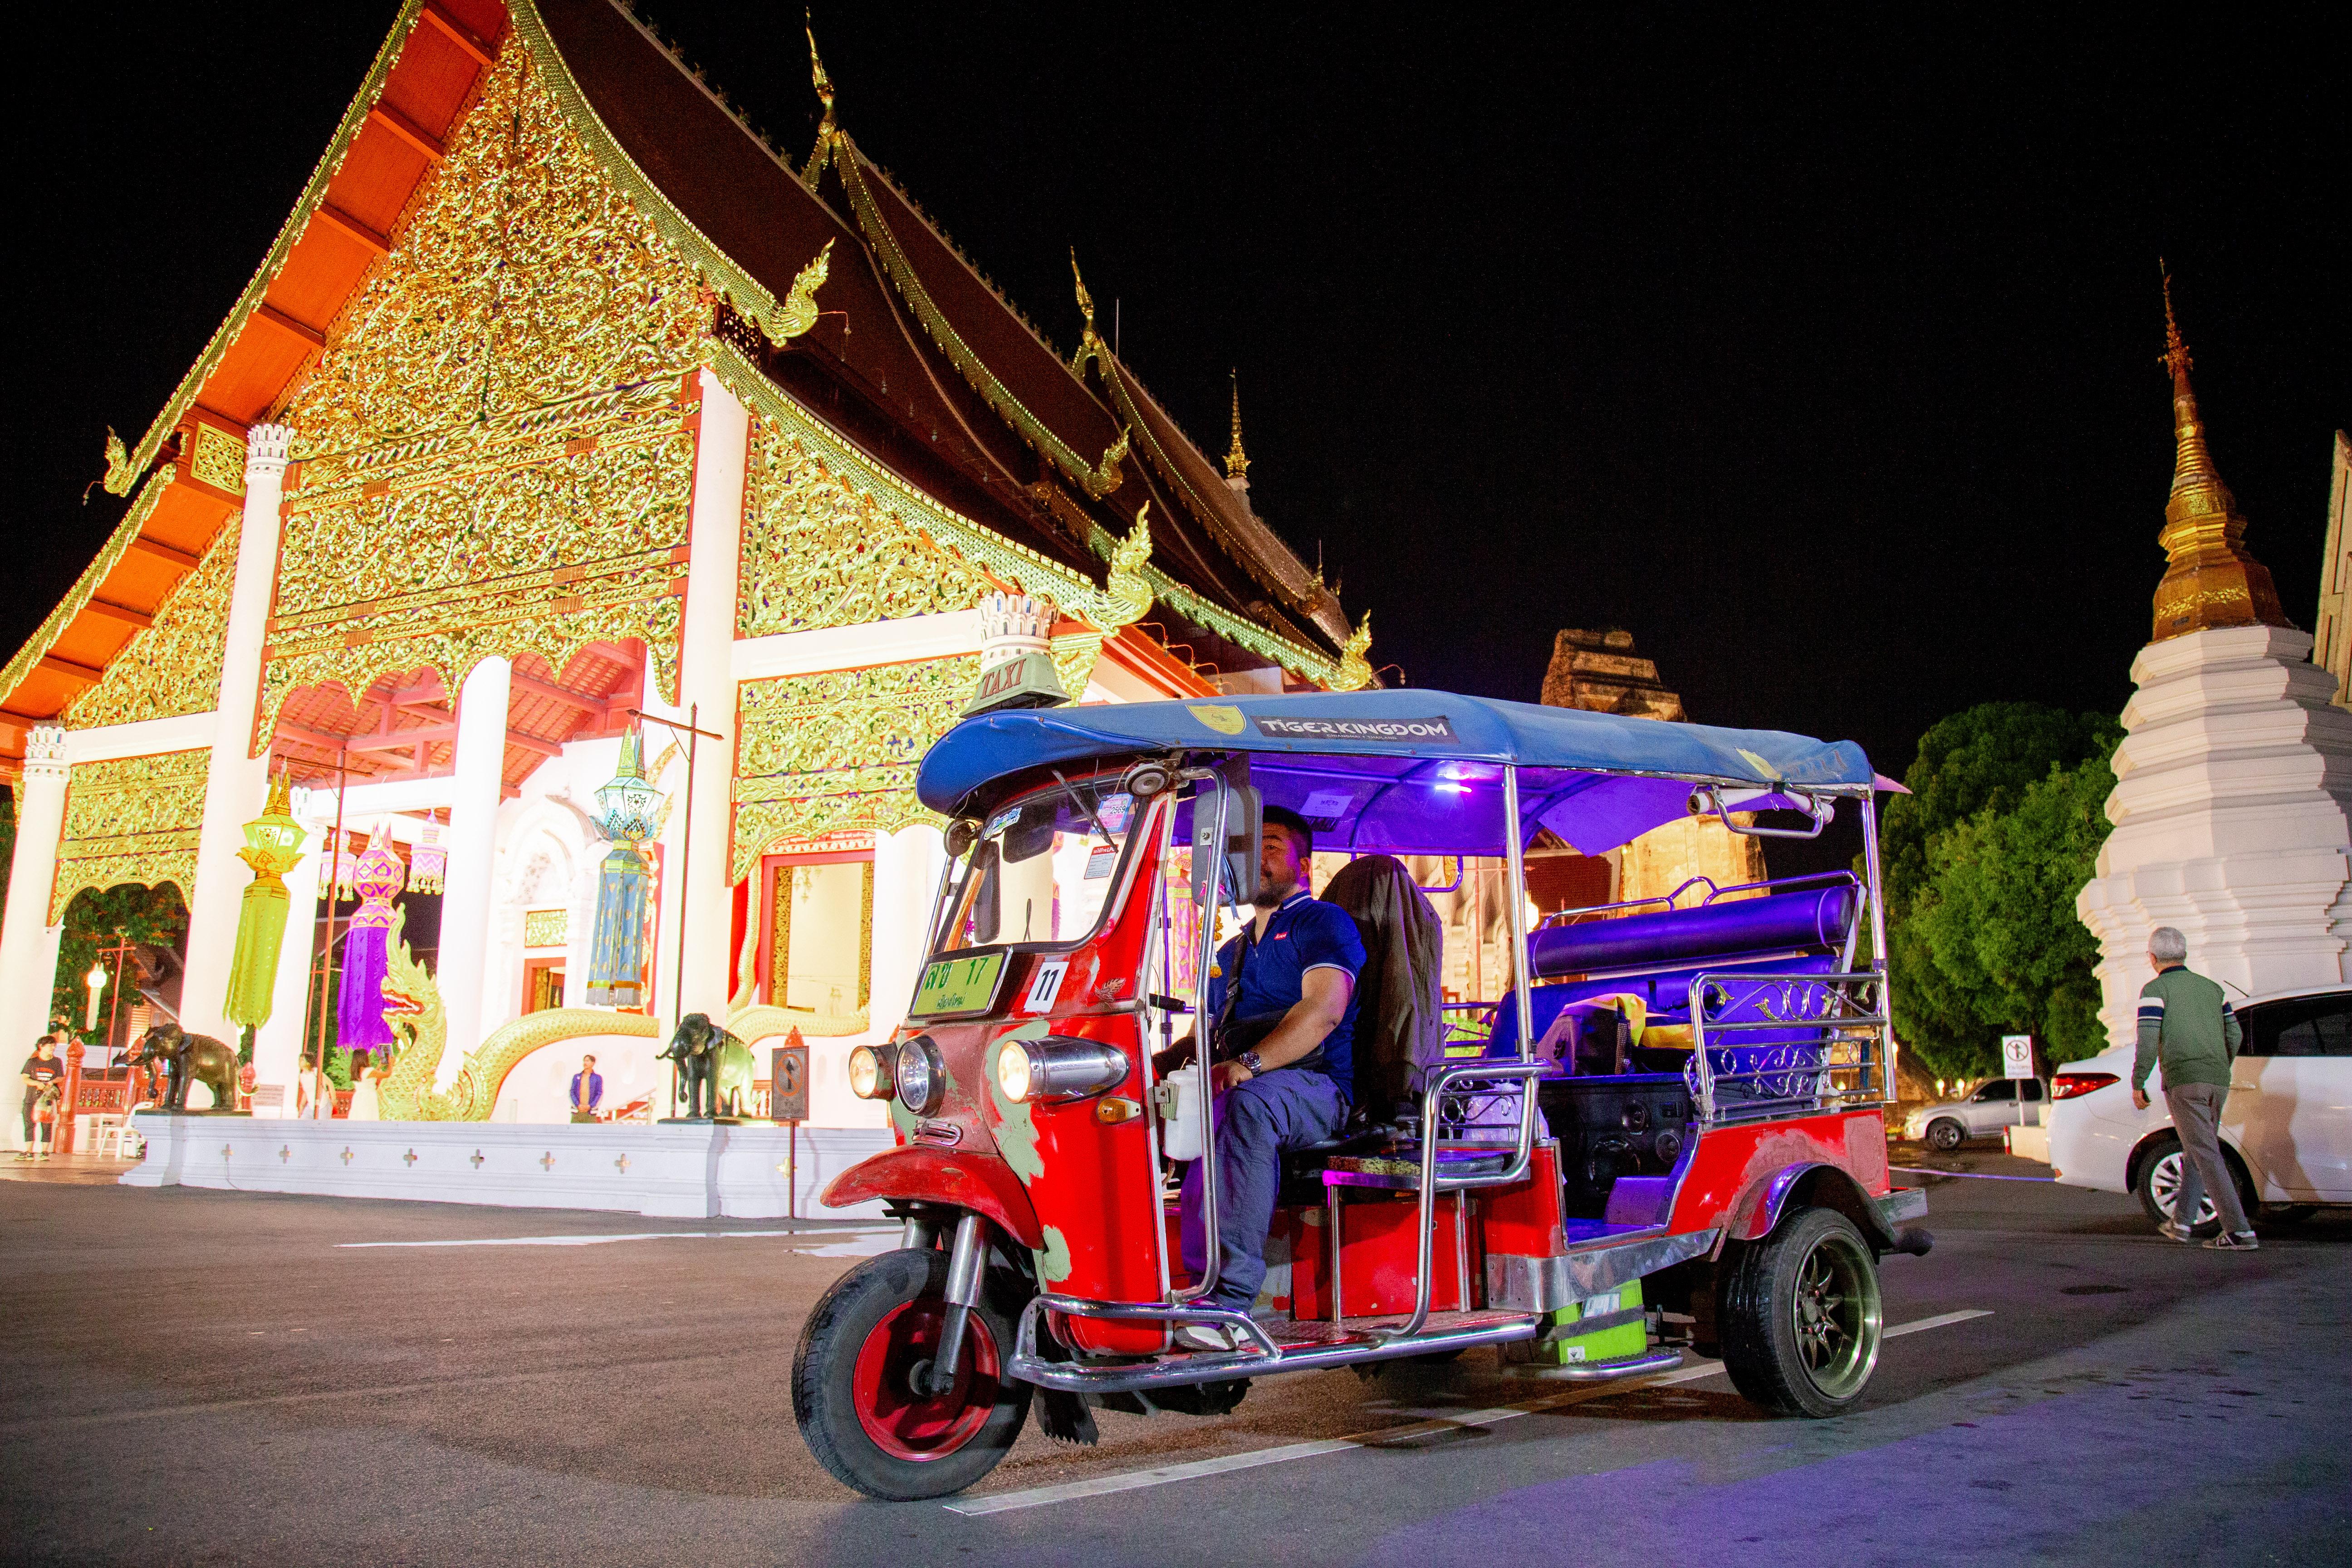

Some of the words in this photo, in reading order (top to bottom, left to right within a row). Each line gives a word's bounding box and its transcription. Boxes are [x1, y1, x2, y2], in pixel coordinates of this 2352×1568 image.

[980, 658, 1026, 699] TAXI
[1110, 805, 1126, 814] 2569
[966, 957, 989, 985] 17
[1035, 969, 1059, 1001] 11
